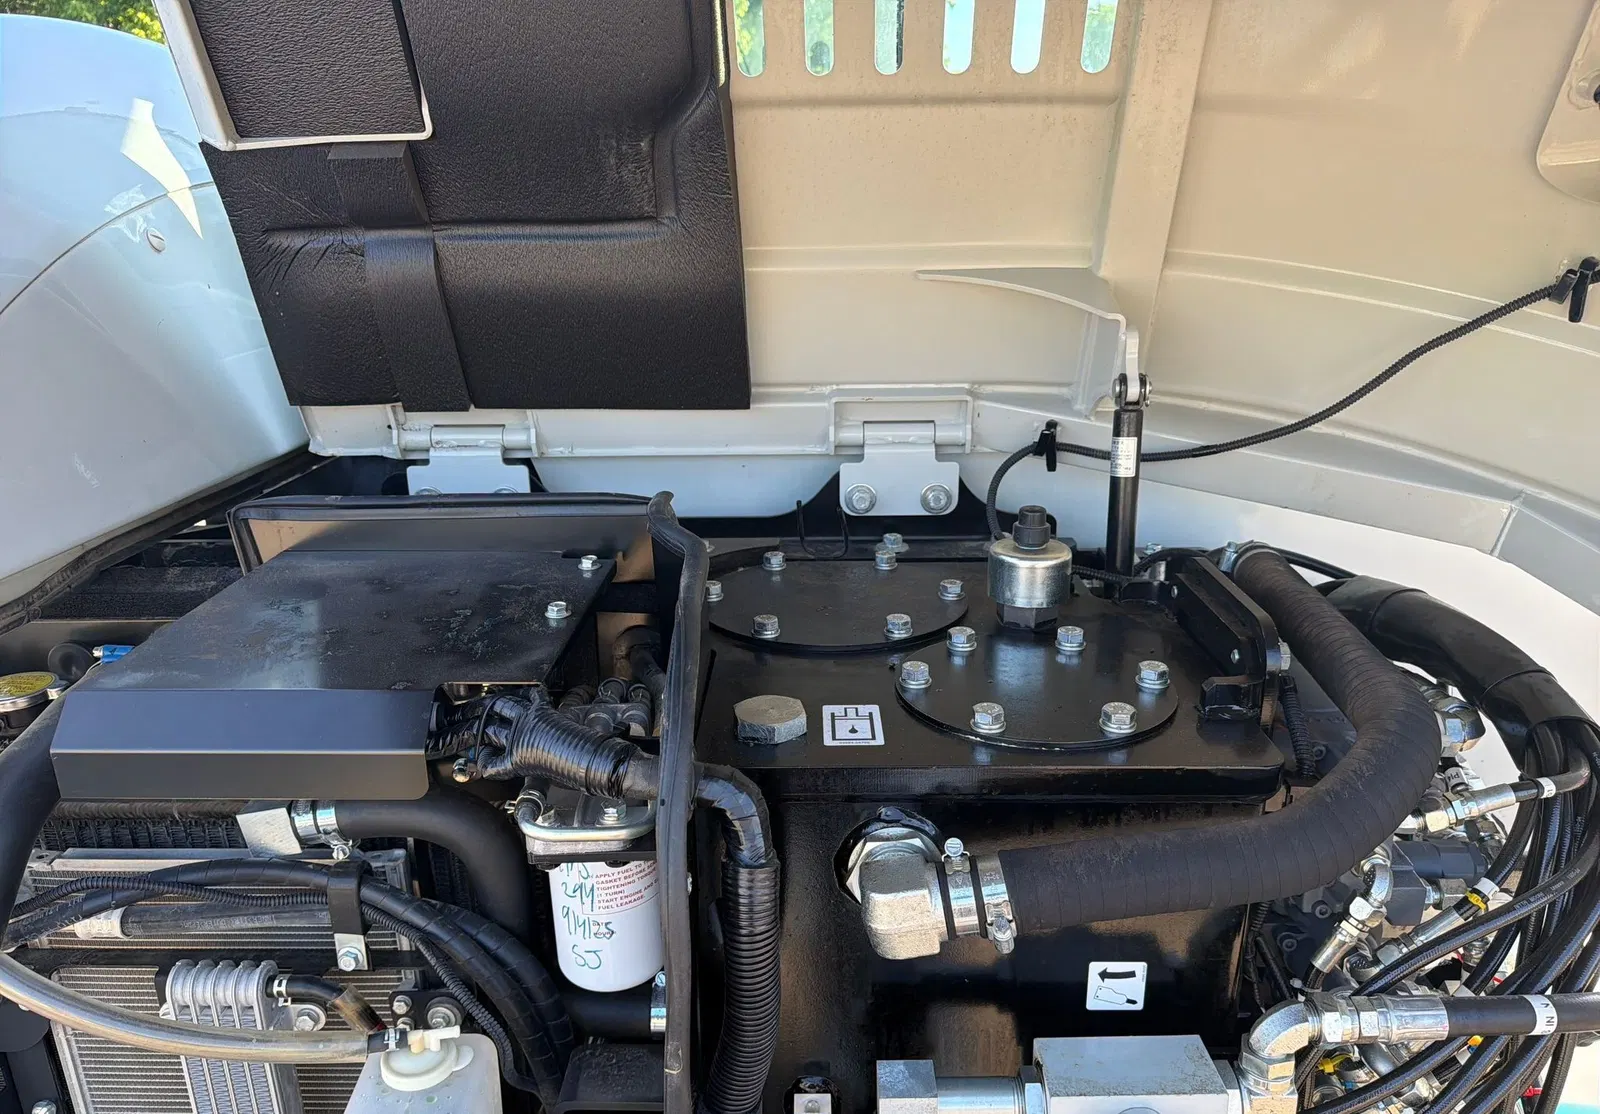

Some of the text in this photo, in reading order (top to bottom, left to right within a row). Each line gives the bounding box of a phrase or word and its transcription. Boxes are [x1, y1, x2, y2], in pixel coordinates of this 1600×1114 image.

[596, 877, 621, 885] GASKET
[624, 868, 646, 880] BEFORE
[596, 880, 636, 891] TIGHTENING
[620, 890, 643, 900] ENGINE
